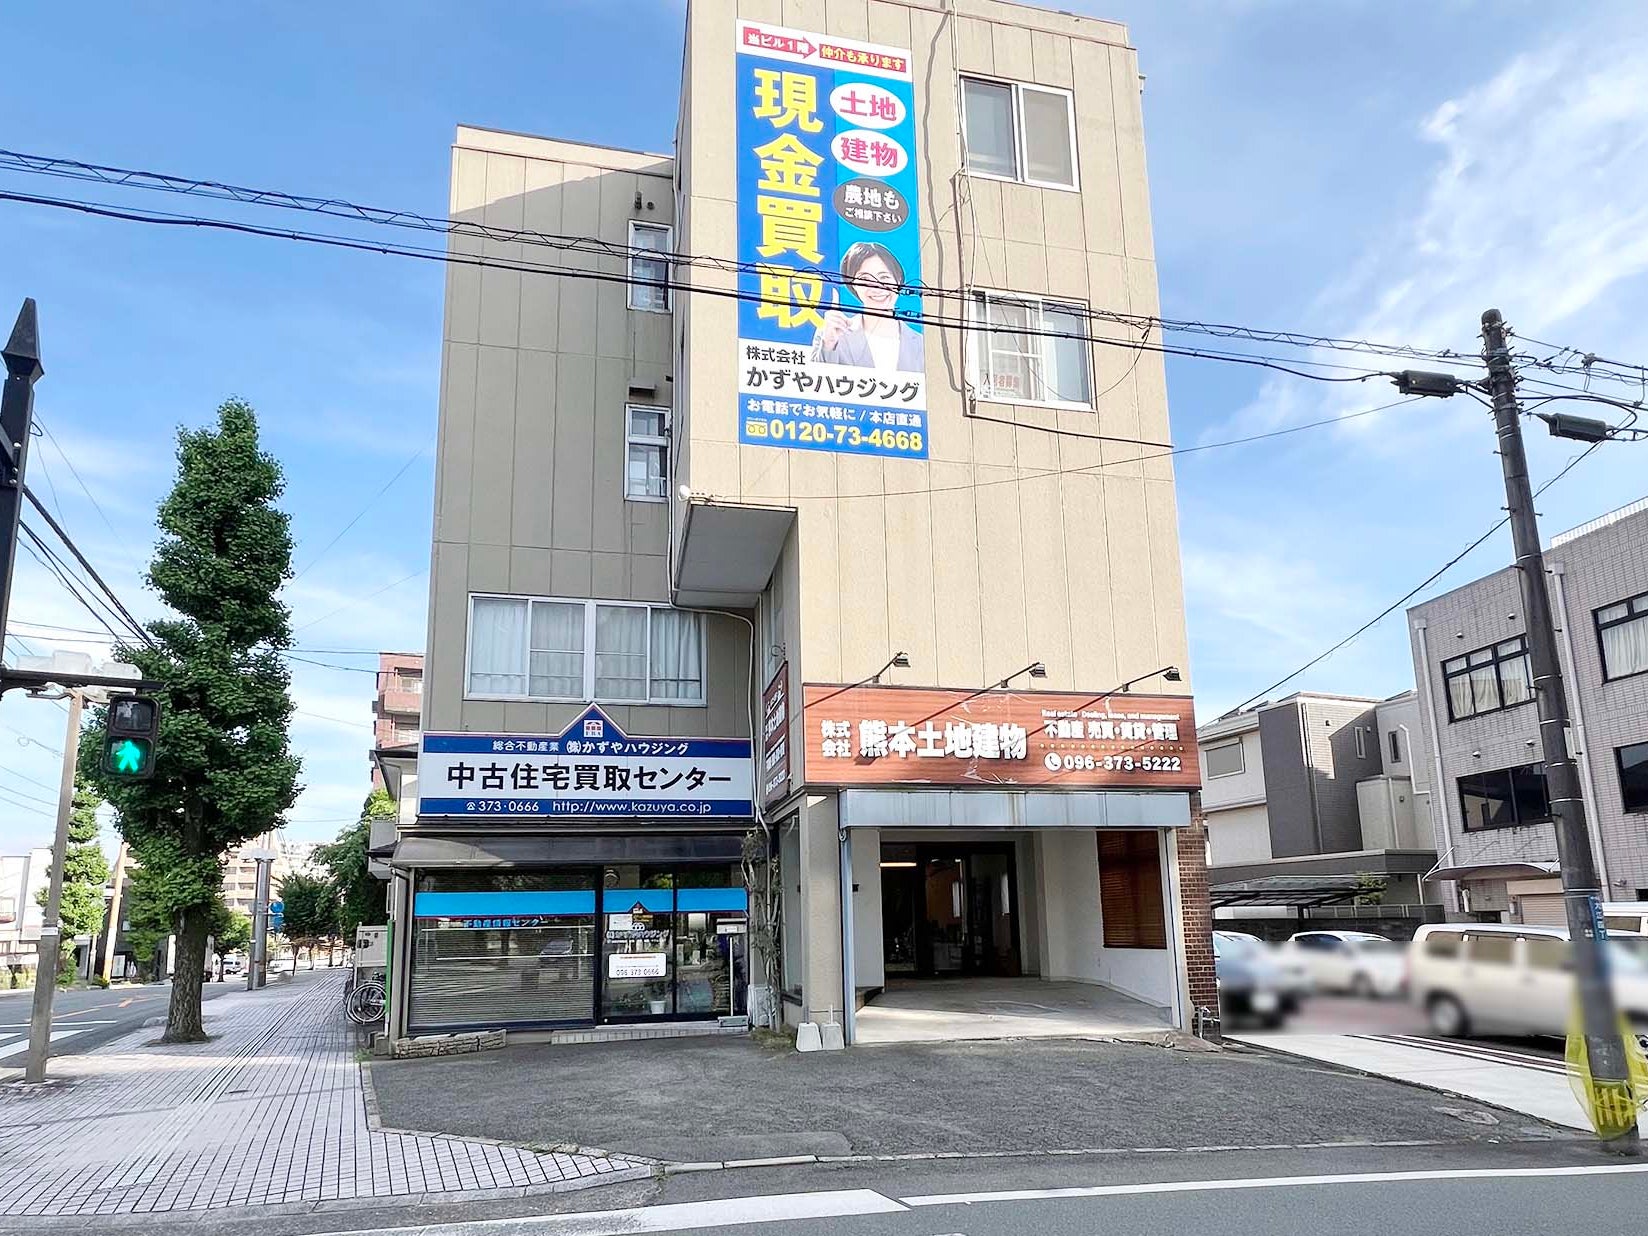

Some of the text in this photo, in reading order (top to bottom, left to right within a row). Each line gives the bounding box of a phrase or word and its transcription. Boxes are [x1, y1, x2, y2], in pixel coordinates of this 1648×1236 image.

[820, 46, 905, 70] 仲介も承ります
[839, 90, 897, 122] 土地
[840, 136, 898, 168] 建物
[752, 68, 826, 331] 現金買取
[843, 184, 900, 211] 農地も
[844, 207, 902, 224] ご相談下さい
[746, 345, 806, 366] 株式会社
[746, 366, 920, 403] かずやハウジング
[747, 398, 857, 421] お電話でお気軽に
[869, 410, 922, 428] 本店直通
[769, 419, 923, 451] 0120-73-4668
[820, 719, 851, 738] 株式
[858, 719, 1027, 760] 熊本土地建物
[821, 739, 852, 758] 会社
[1063, 754, 1182, 771] 096-373-5222
[447, 761, 731, 792] 中古住宅買取センター
[552, 800, 712, 814] http://www.kazuya.co.jp
